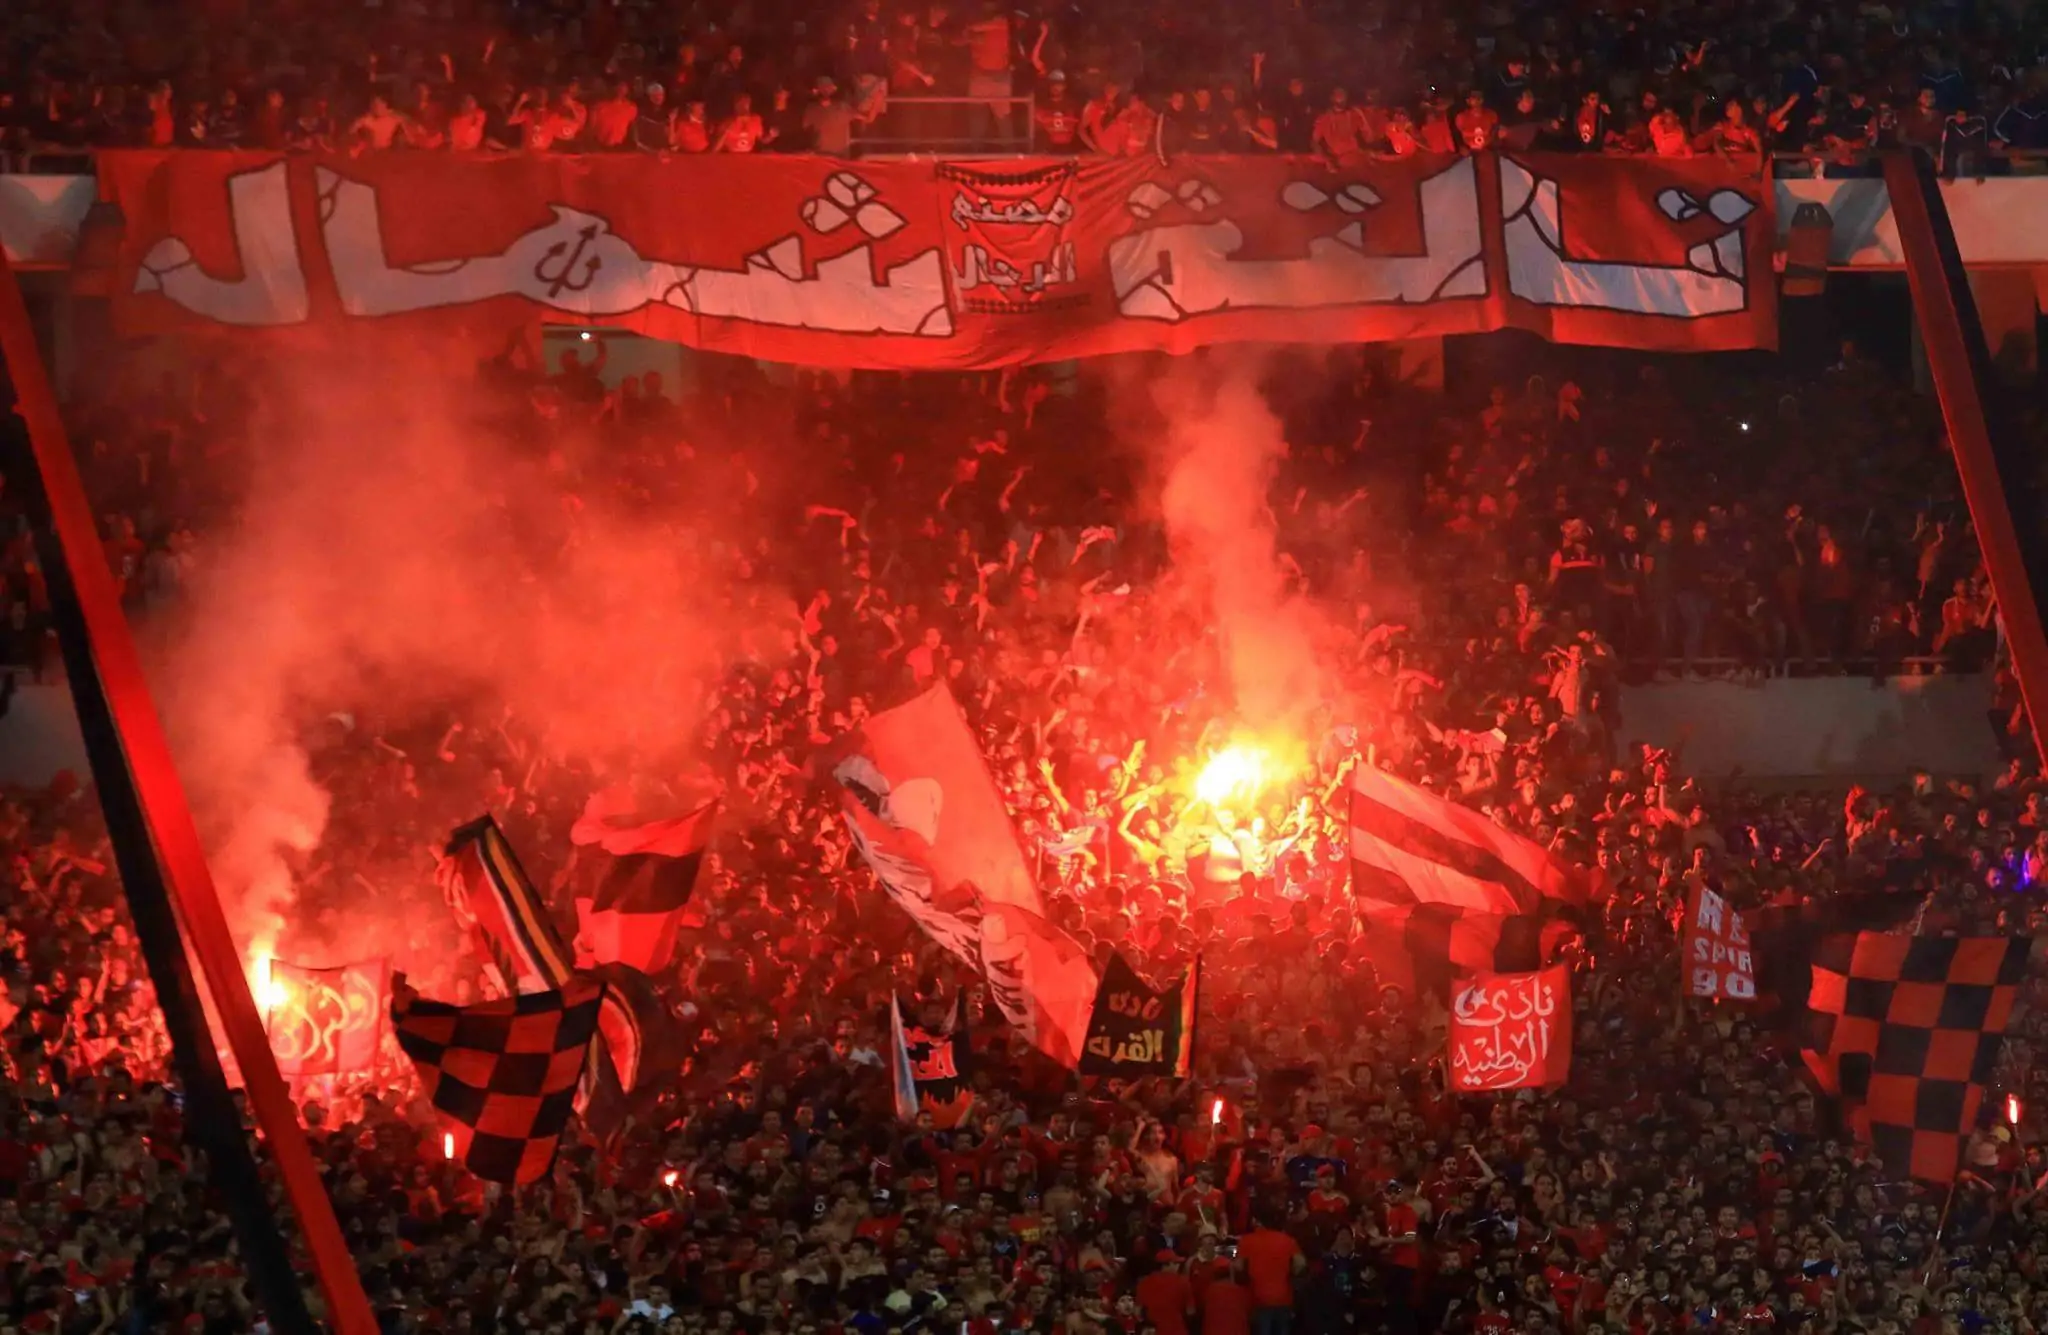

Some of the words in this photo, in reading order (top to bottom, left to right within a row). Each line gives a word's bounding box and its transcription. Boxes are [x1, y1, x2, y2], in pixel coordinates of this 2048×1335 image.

[951, 190, 1074, 232] مصنع
[134, 160, 956, 338] شمال
[951, 241, 1076, 293] الرجال
